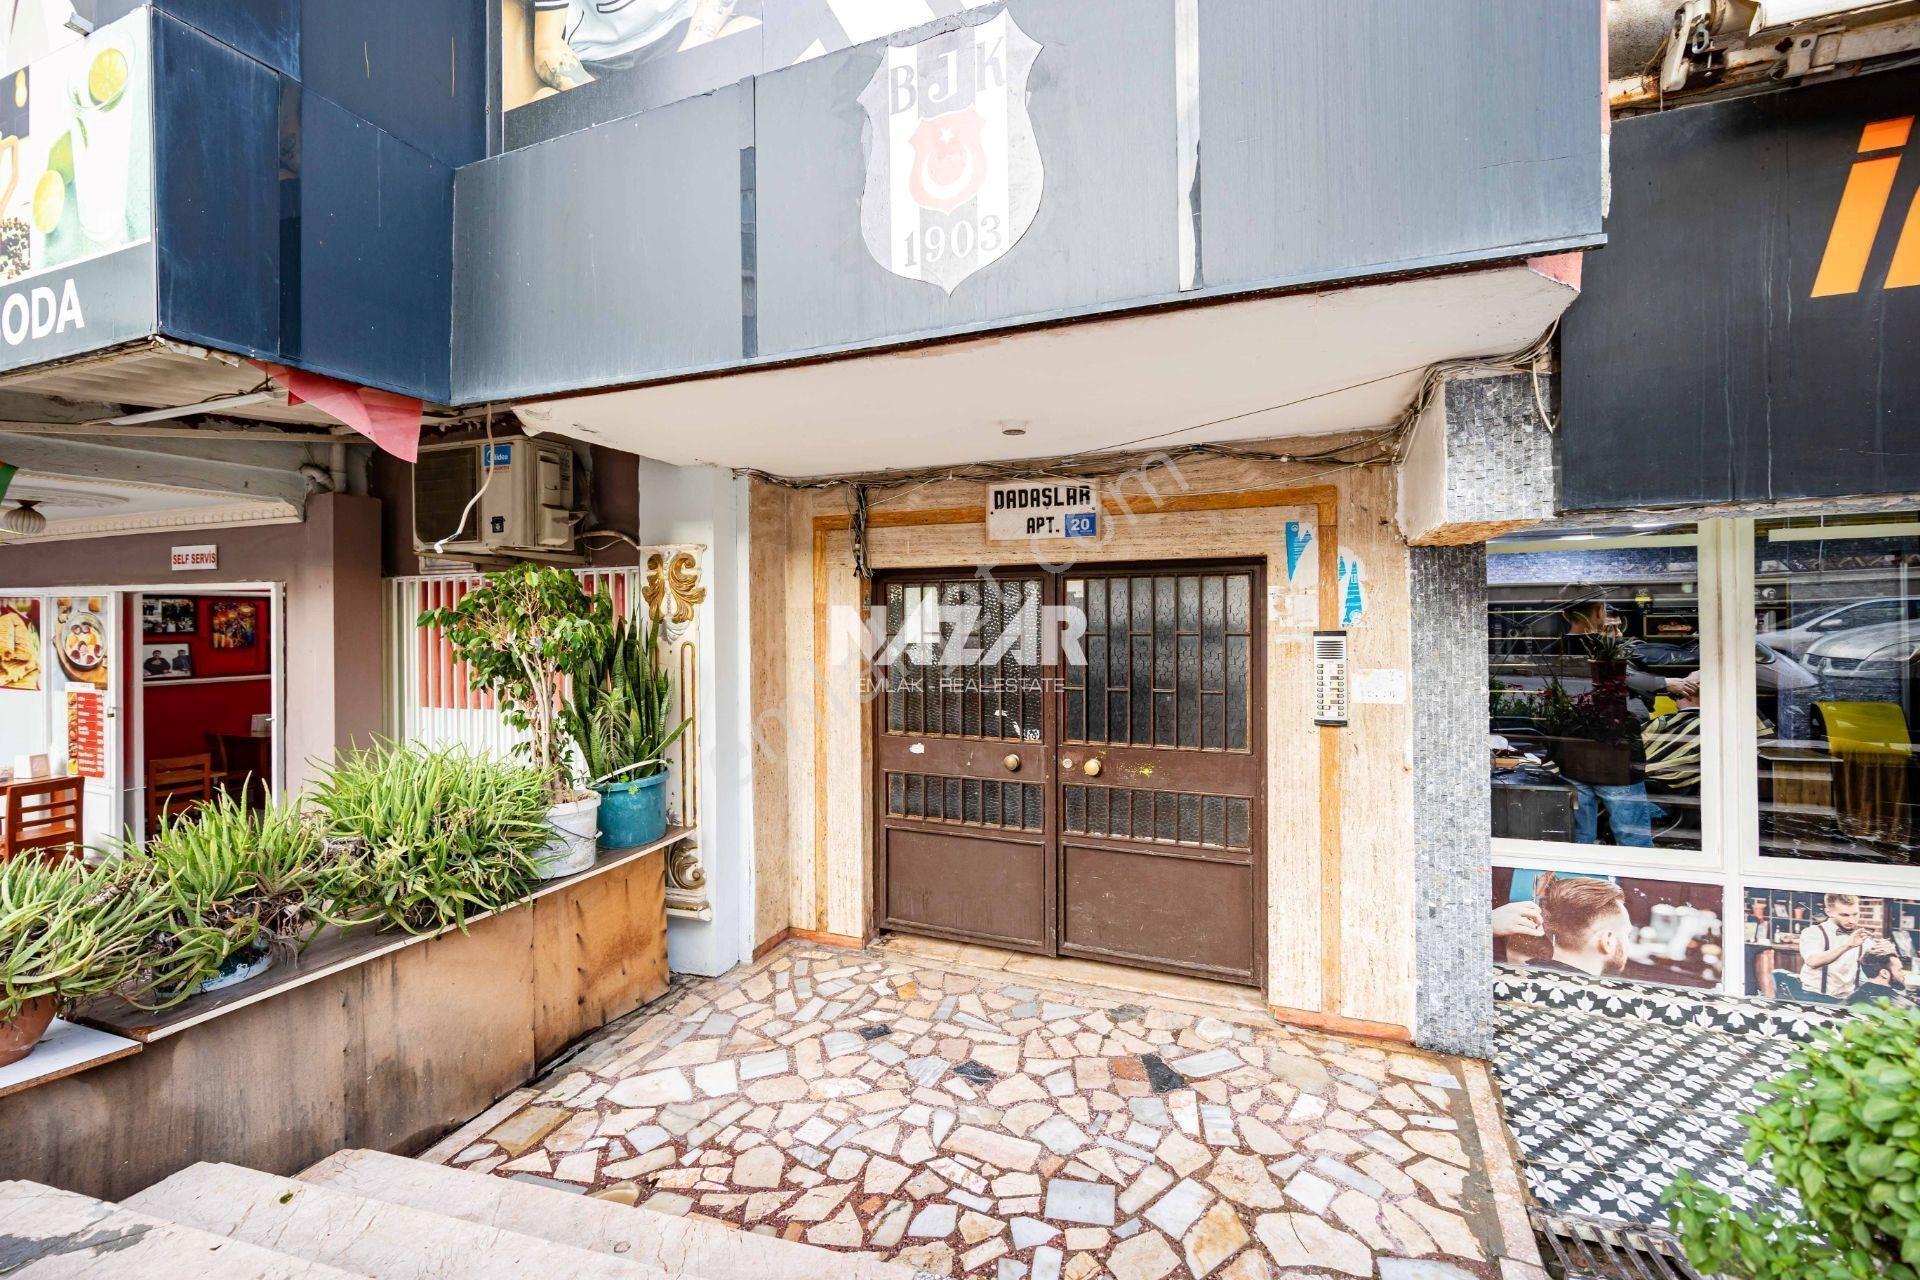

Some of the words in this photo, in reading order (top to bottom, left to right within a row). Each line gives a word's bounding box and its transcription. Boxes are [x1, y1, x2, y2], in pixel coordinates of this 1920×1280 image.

[890, 36, 1006, 116] BJK
[904, 214, 1002, 267] 1903
[0, 278, 85, 346] ODA
[1026, 516, 1060, 534] APT.
[1070, 518, 1090, 531] 20
[173, 554, 189, 564] SELF
[191, 550, 216, 564] SERVİS
